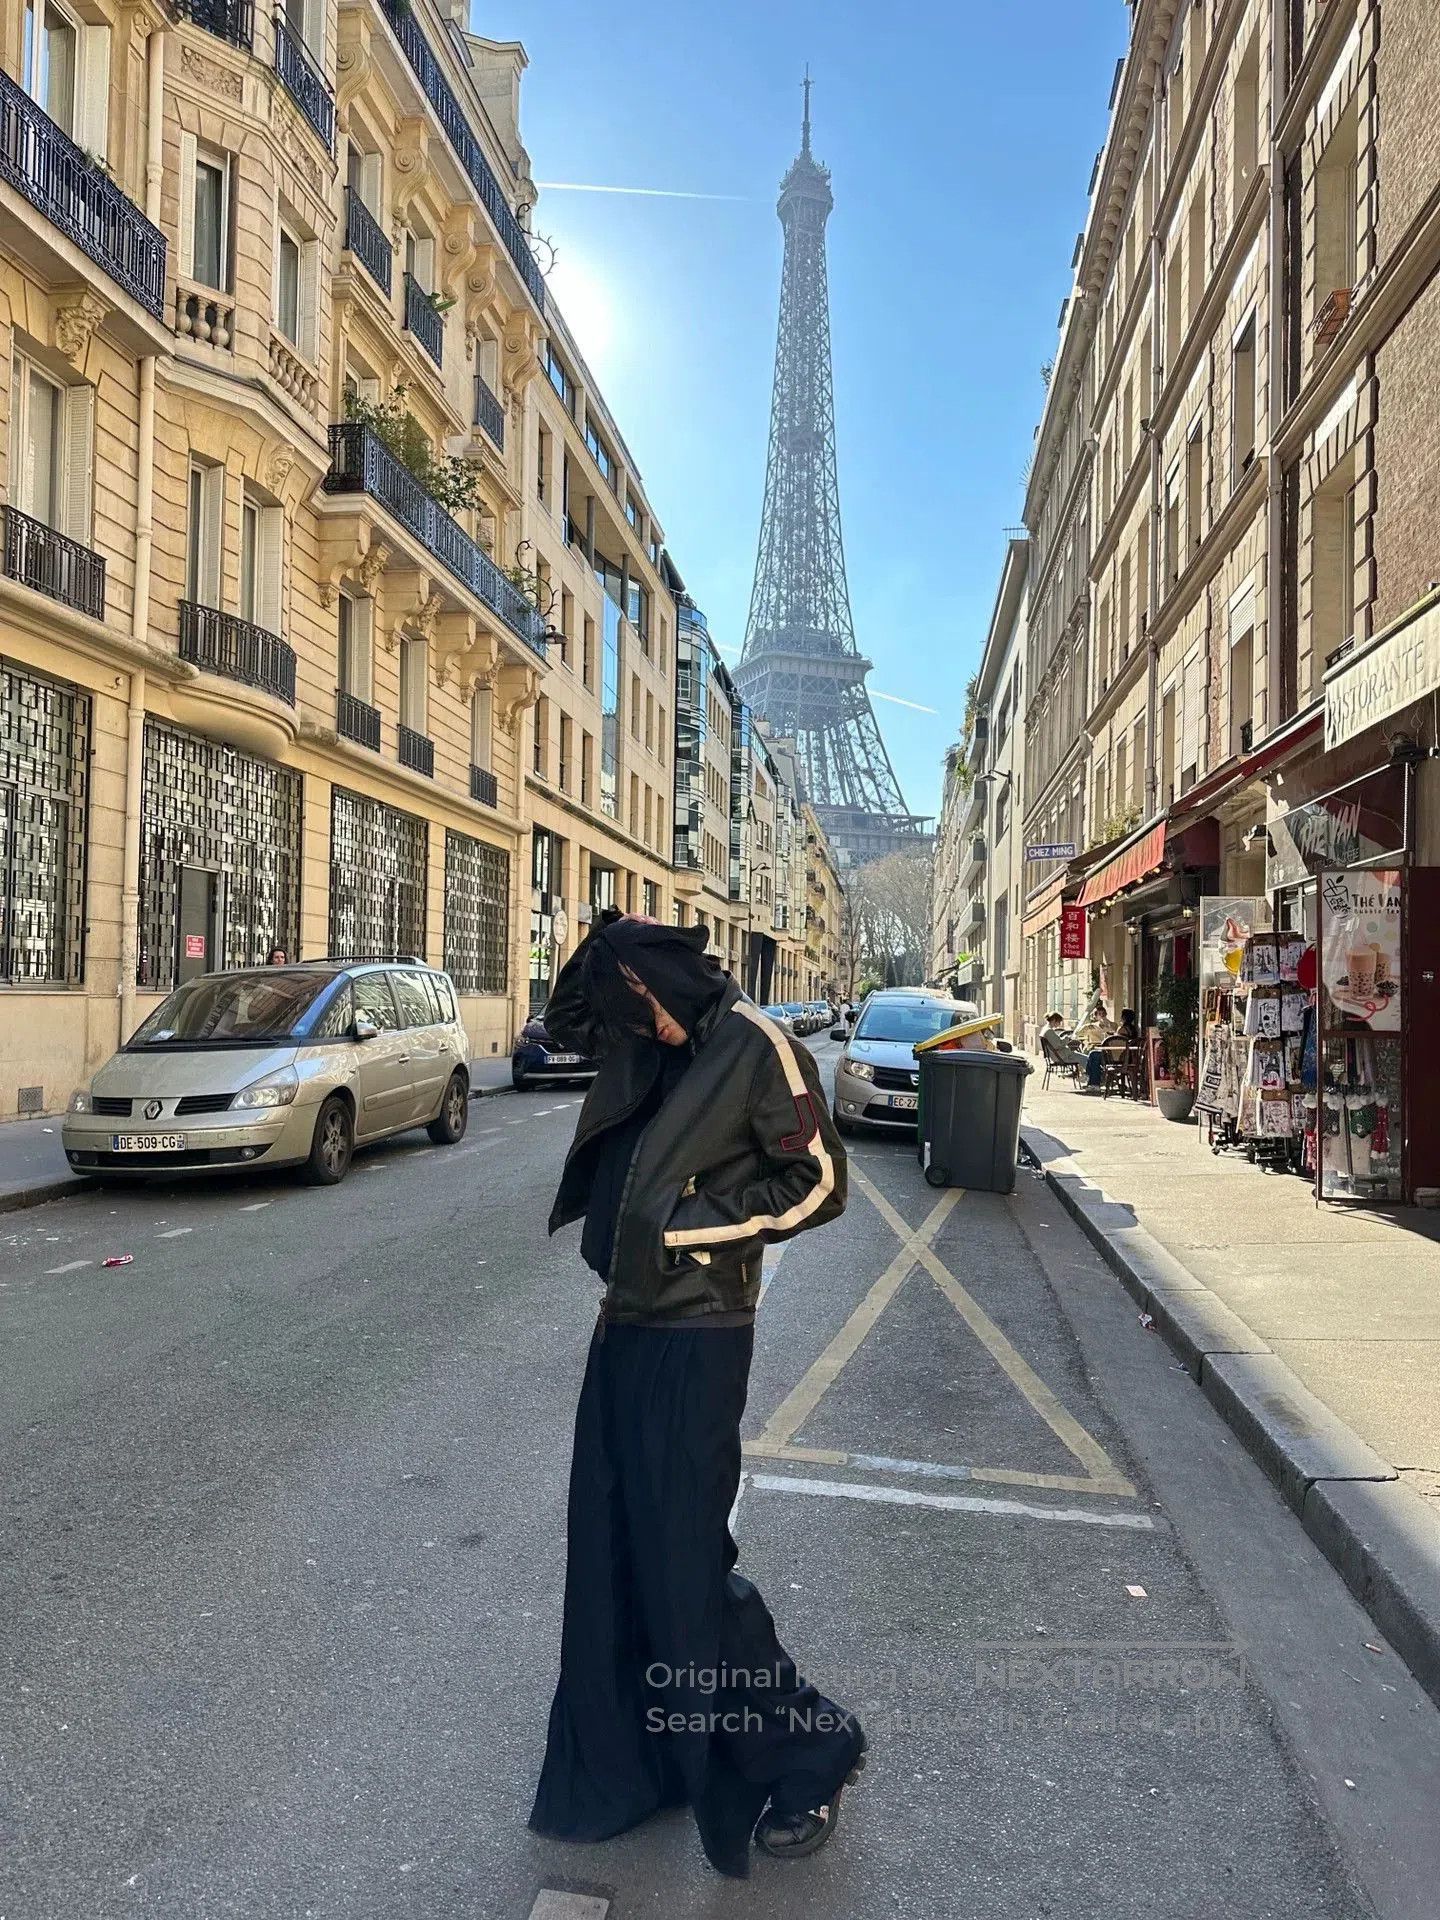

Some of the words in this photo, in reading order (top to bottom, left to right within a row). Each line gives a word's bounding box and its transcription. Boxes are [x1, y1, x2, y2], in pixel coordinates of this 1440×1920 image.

[1327, 639, 1425, 729] RISTORANTE
[1028, 848, 1050, 858] CHEZ
[1052, 846, 1074, 856] MING
[1351, 893, 1375, 907] THÉ
[1063, 949, 1081, 957] Ming
[120, 1135, 176, 1150] DE-509-CG
